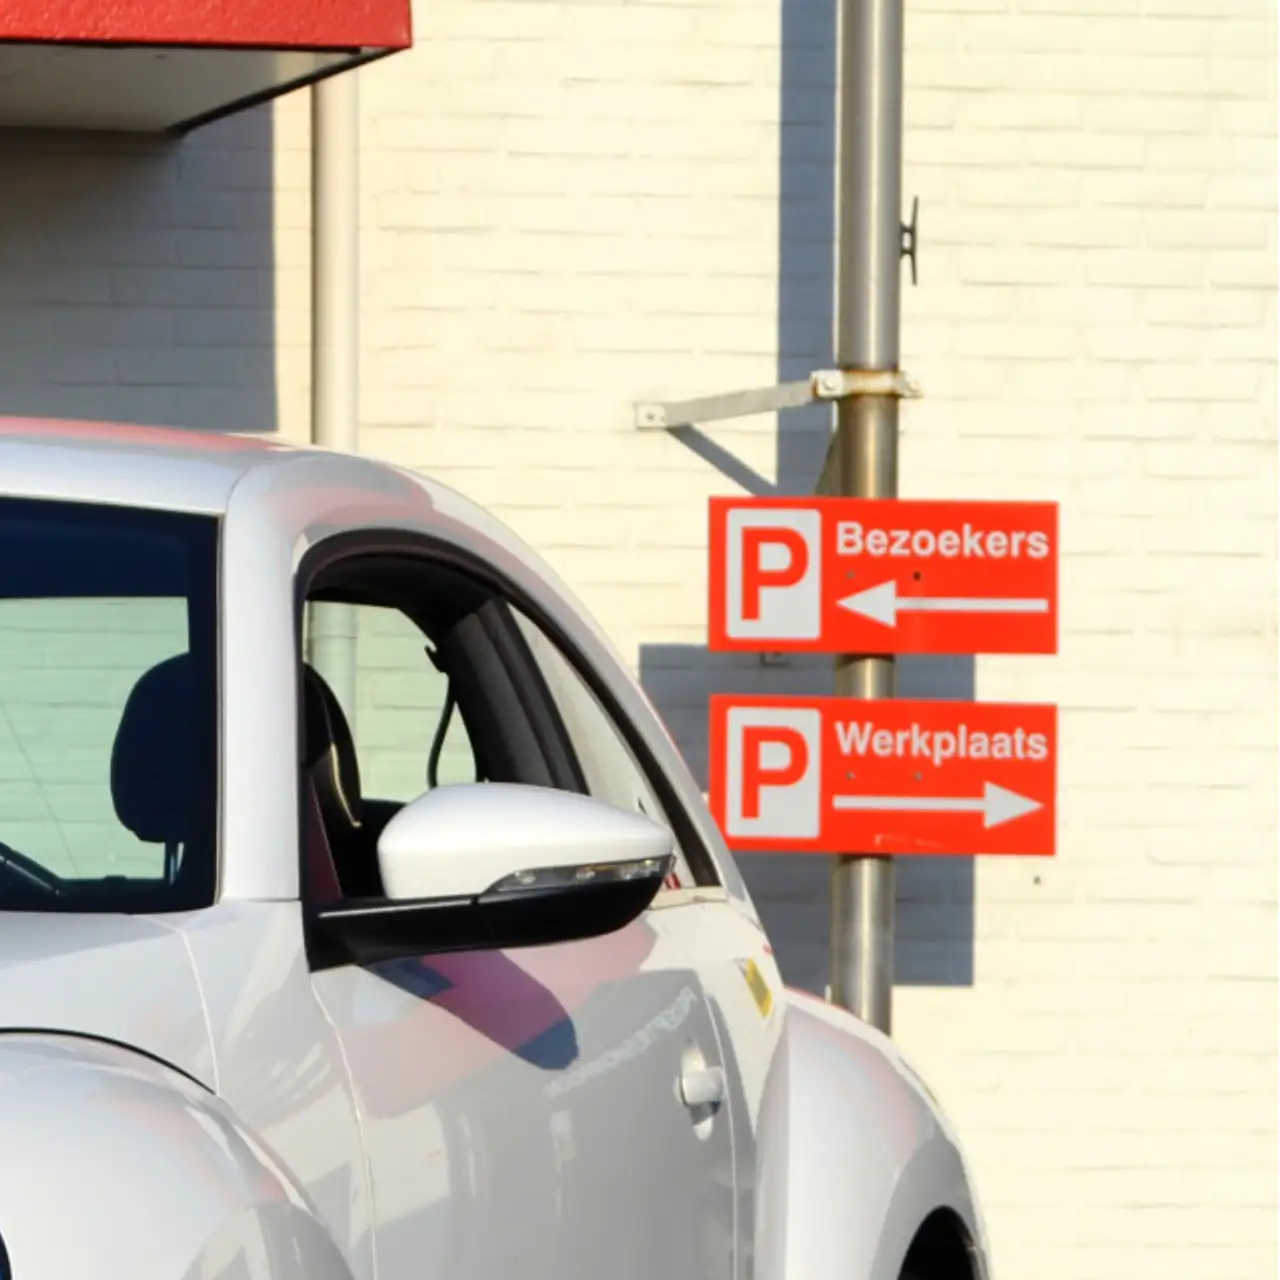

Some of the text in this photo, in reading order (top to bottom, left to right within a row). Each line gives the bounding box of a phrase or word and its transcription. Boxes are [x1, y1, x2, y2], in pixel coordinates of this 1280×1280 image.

[741, 526, 809, 621] P
[835, 520, 1050, 558] Bezoekers
[741, 725, 808, 819] P
[833, 720, 1049, 767] Werkplaats
